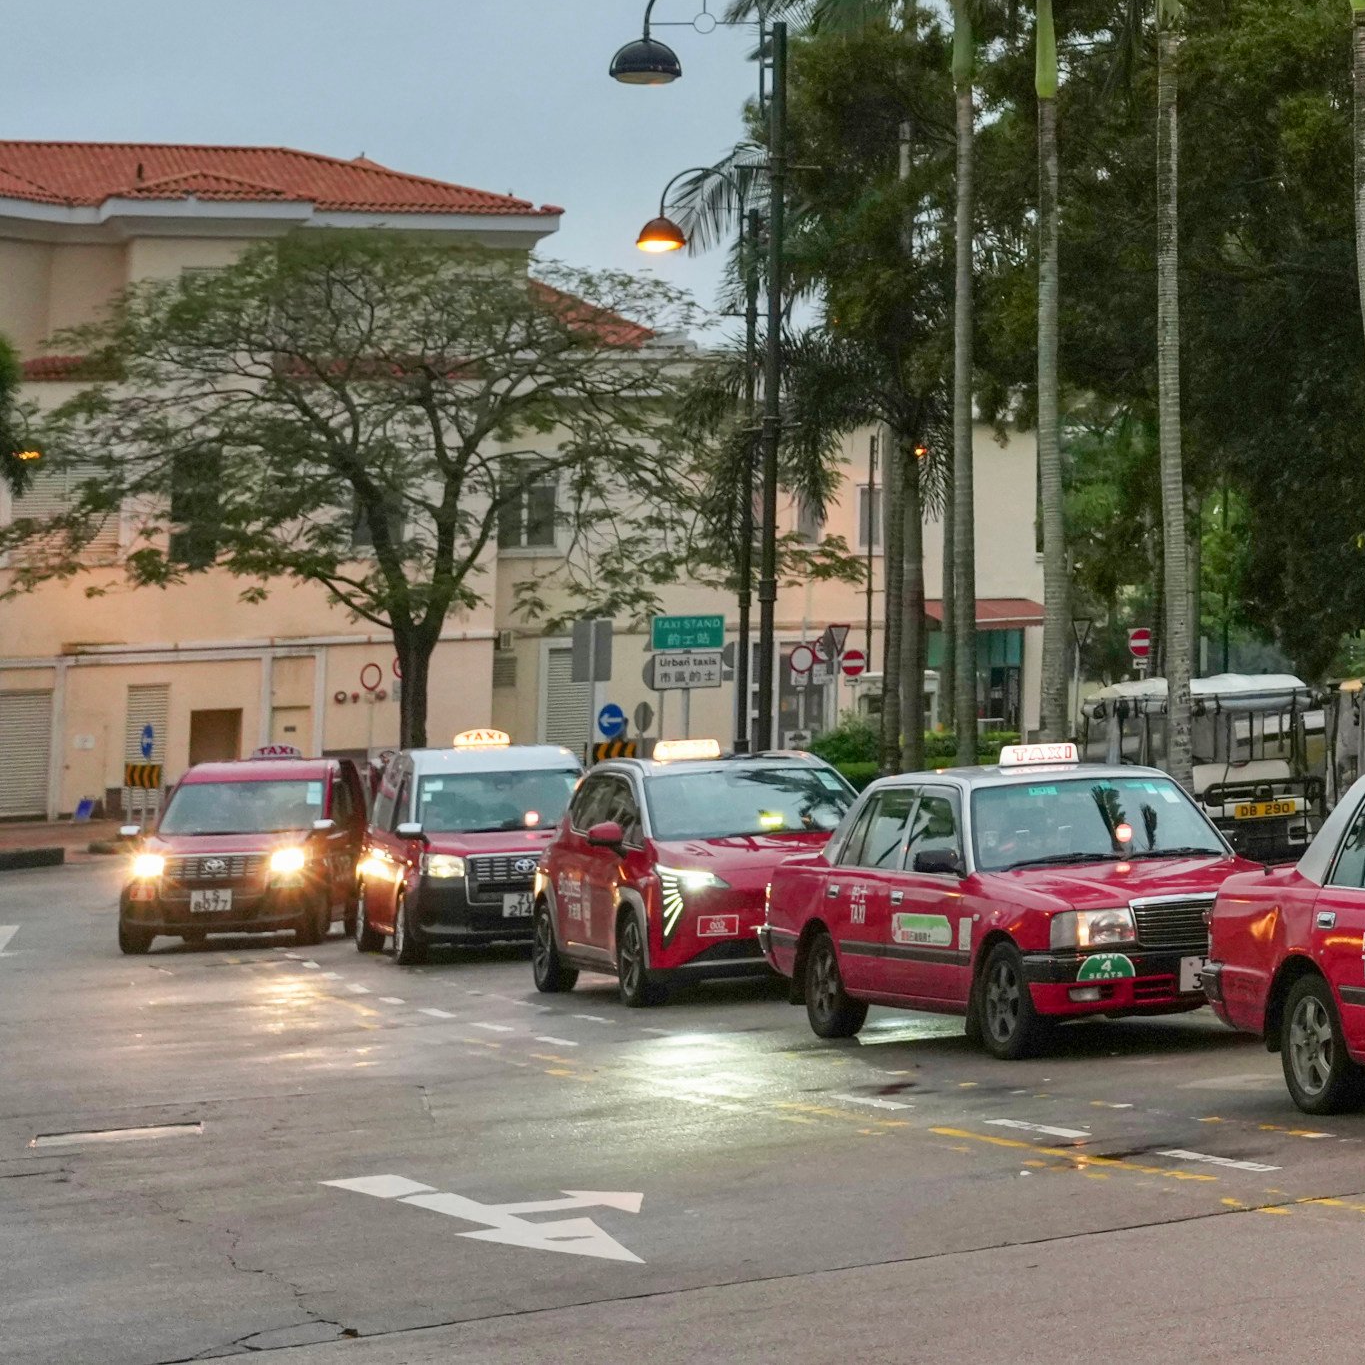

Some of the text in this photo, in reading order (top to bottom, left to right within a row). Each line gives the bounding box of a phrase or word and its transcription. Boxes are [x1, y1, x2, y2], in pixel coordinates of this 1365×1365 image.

[657, 618, 720, 629] TAXI STAND
[668, 633, 710, 645] 的士站
[660, 657, 717, 667] Urban taxis
[464, 732, 502, 741] TAXI
[258, 746, 294, 755] TAXI
[1013, 746, 1072, 761] TAXI
[1241, 803, 1290, 816] DB 290
[850, 904, 866, 924] TAXI
[1101, 960, 1113, 971] 4
[1089, 971, 1123, 979] SEATS
